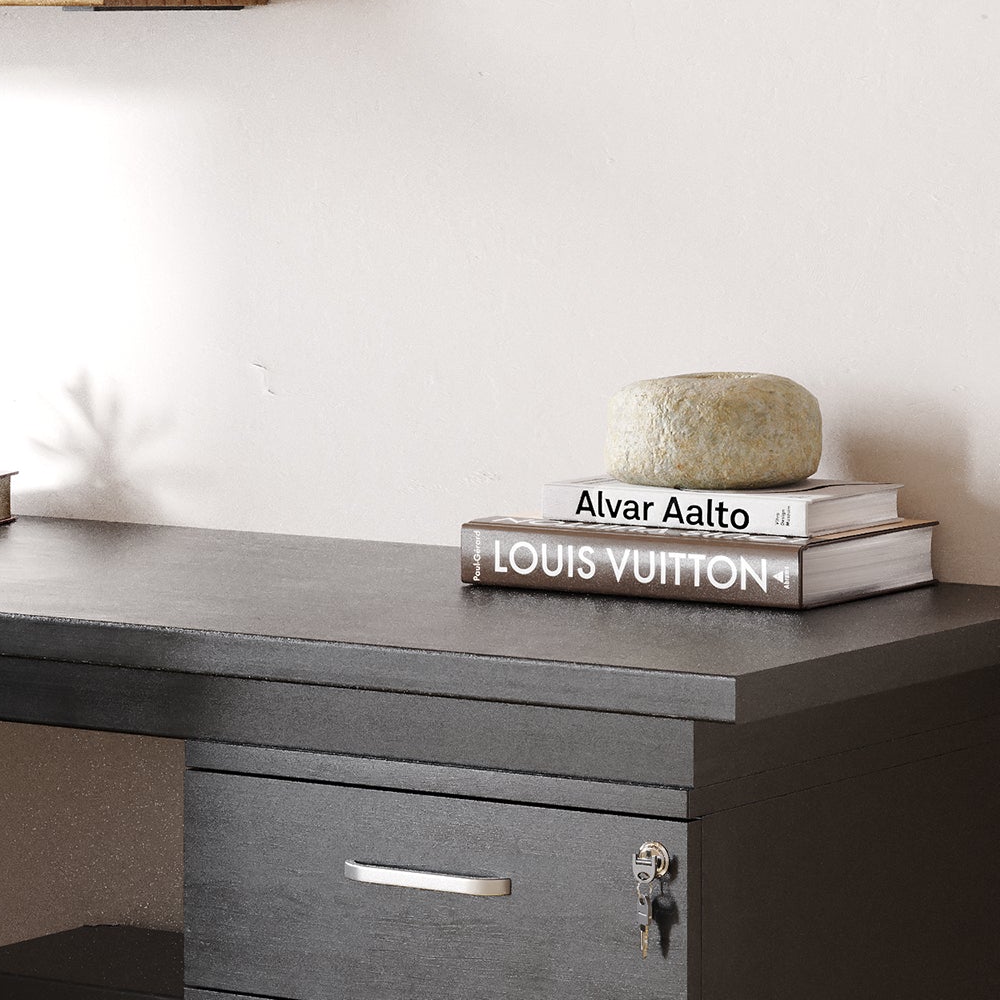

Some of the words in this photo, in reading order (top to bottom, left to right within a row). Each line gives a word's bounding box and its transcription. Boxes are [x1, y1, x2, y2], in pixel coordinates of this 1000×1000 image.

[575, 489, 656, 522] Alvar
[662, 496, 751, 532] Aalto
[493, 539, 596, 580] LOUIS
[605, 547, 769, 594] VUITTON
